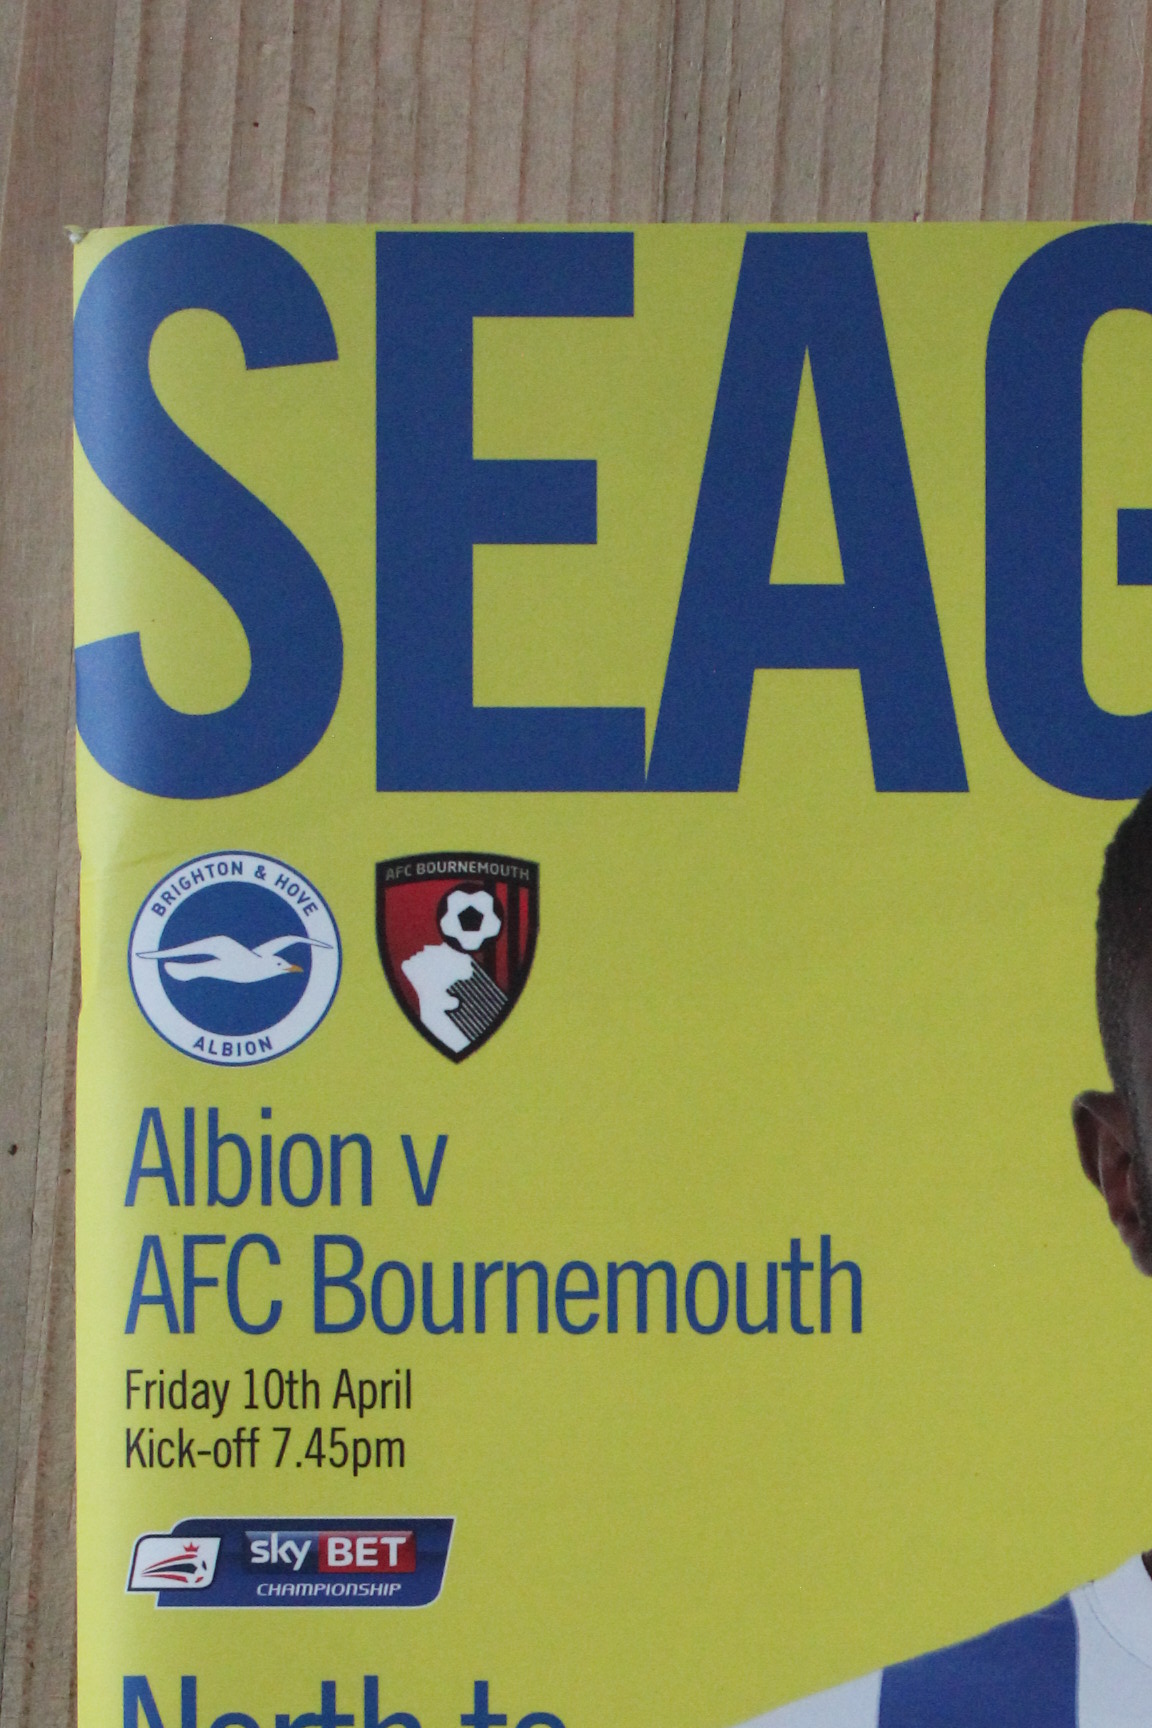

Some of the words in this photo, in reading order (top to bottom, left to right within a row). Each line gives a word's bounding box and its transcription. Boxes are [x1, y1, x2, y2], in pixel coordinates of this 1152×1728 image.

[151, 860, 244, 917] BRIGHTON
[254, 867, 267, 880] &
[274, 874, 319, 918] HOVE
[385, 864, 412, 881] AFC
[416, 861, 530, 881] BOURNEMOUTH
[193, 1035, 274, 1058] ALBION
[124, 1106, 373, 1208] Albion
[400, 1133, 449, 1207] v
[124, 1232, 283, 1336] AFC
[314, 1234, 863, 1336] Bournemouth
[125, 1369, 230, 1418] Friday
[244, 1368, 320, 1410] 10th
[332, 1368, 412, 1418] April
[125, 1427, 260, 1469] Kick-off
[272, 1427, 406, 1477] 7.45pm
[250, 1532, 312, 1571] sky
[327, 1536, 407, 1567] BET
[256, 1583, 402, 1597] CHAMPIONSHIP
